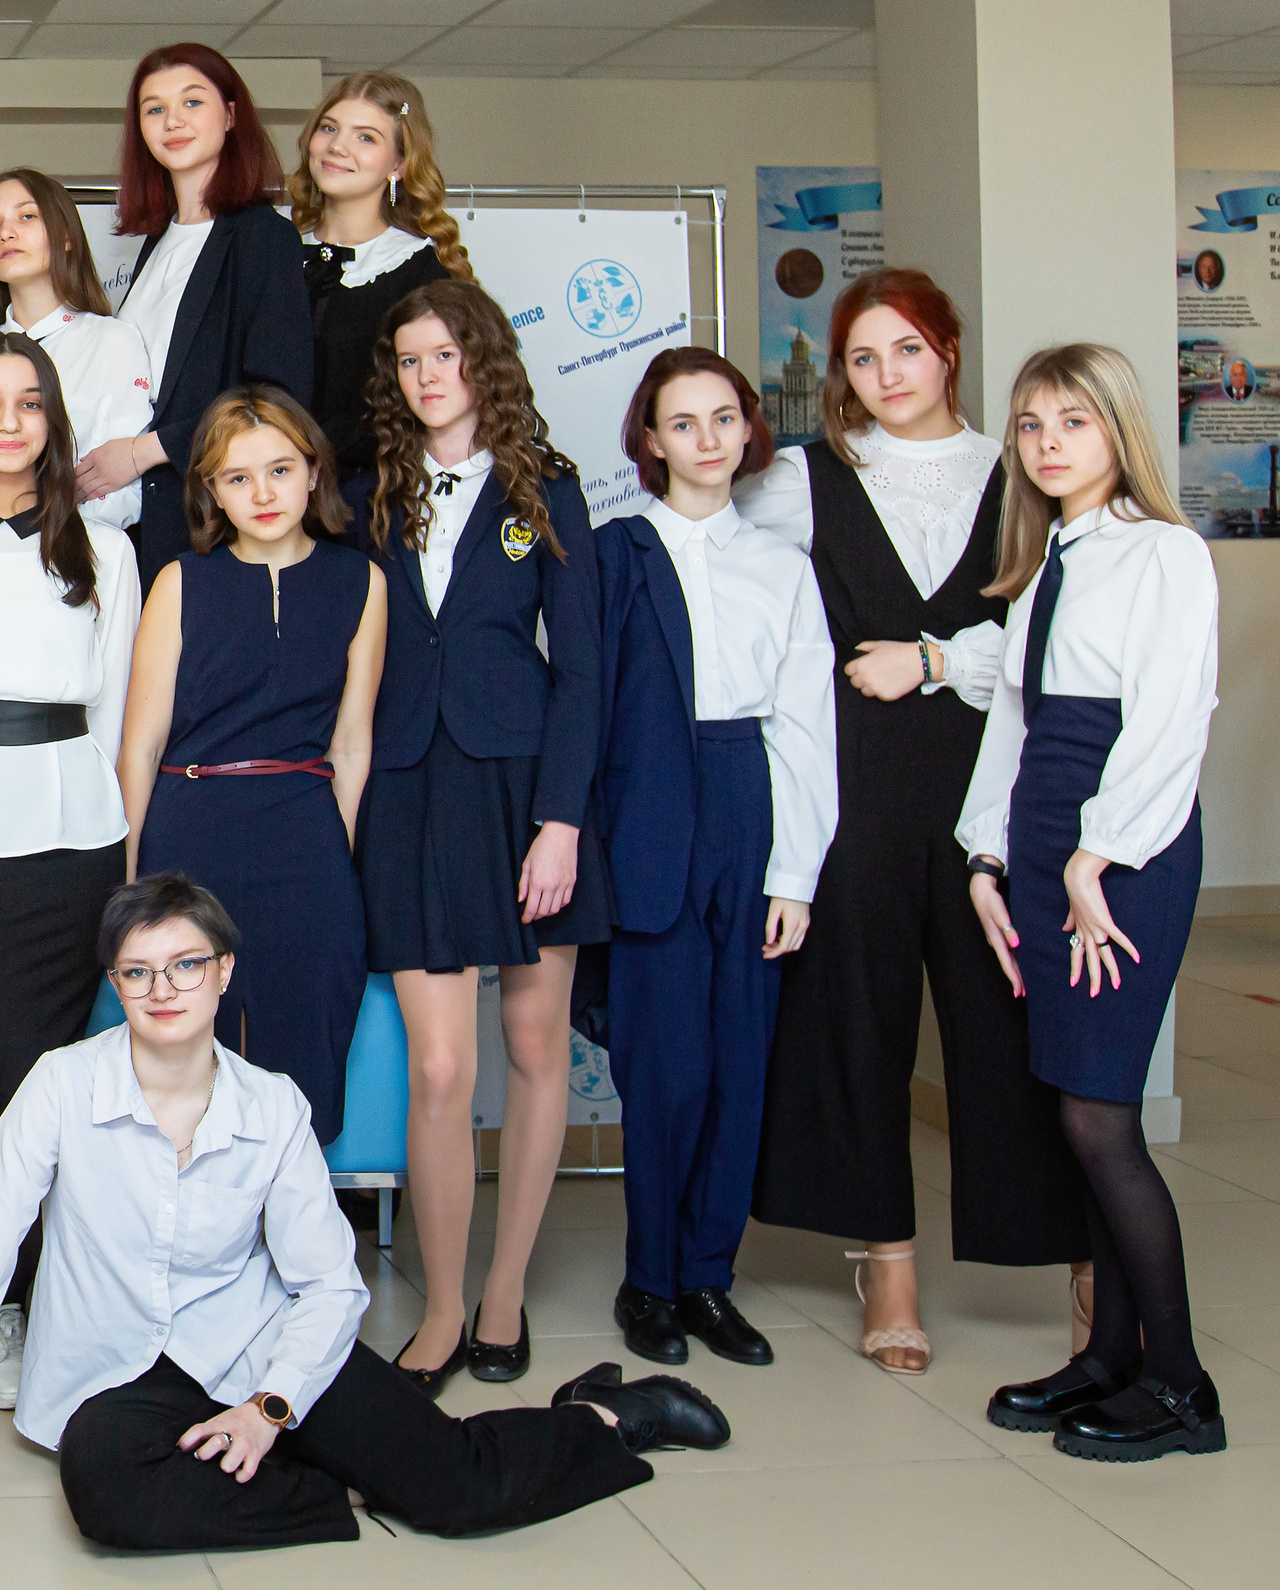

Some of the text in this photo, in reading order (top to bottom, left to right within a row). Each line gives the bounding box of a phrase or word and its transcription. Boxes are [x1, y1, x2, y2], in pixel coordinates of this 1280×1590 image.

[558, 321, 687, 376] Санкт-Петербург Пушкинский район
